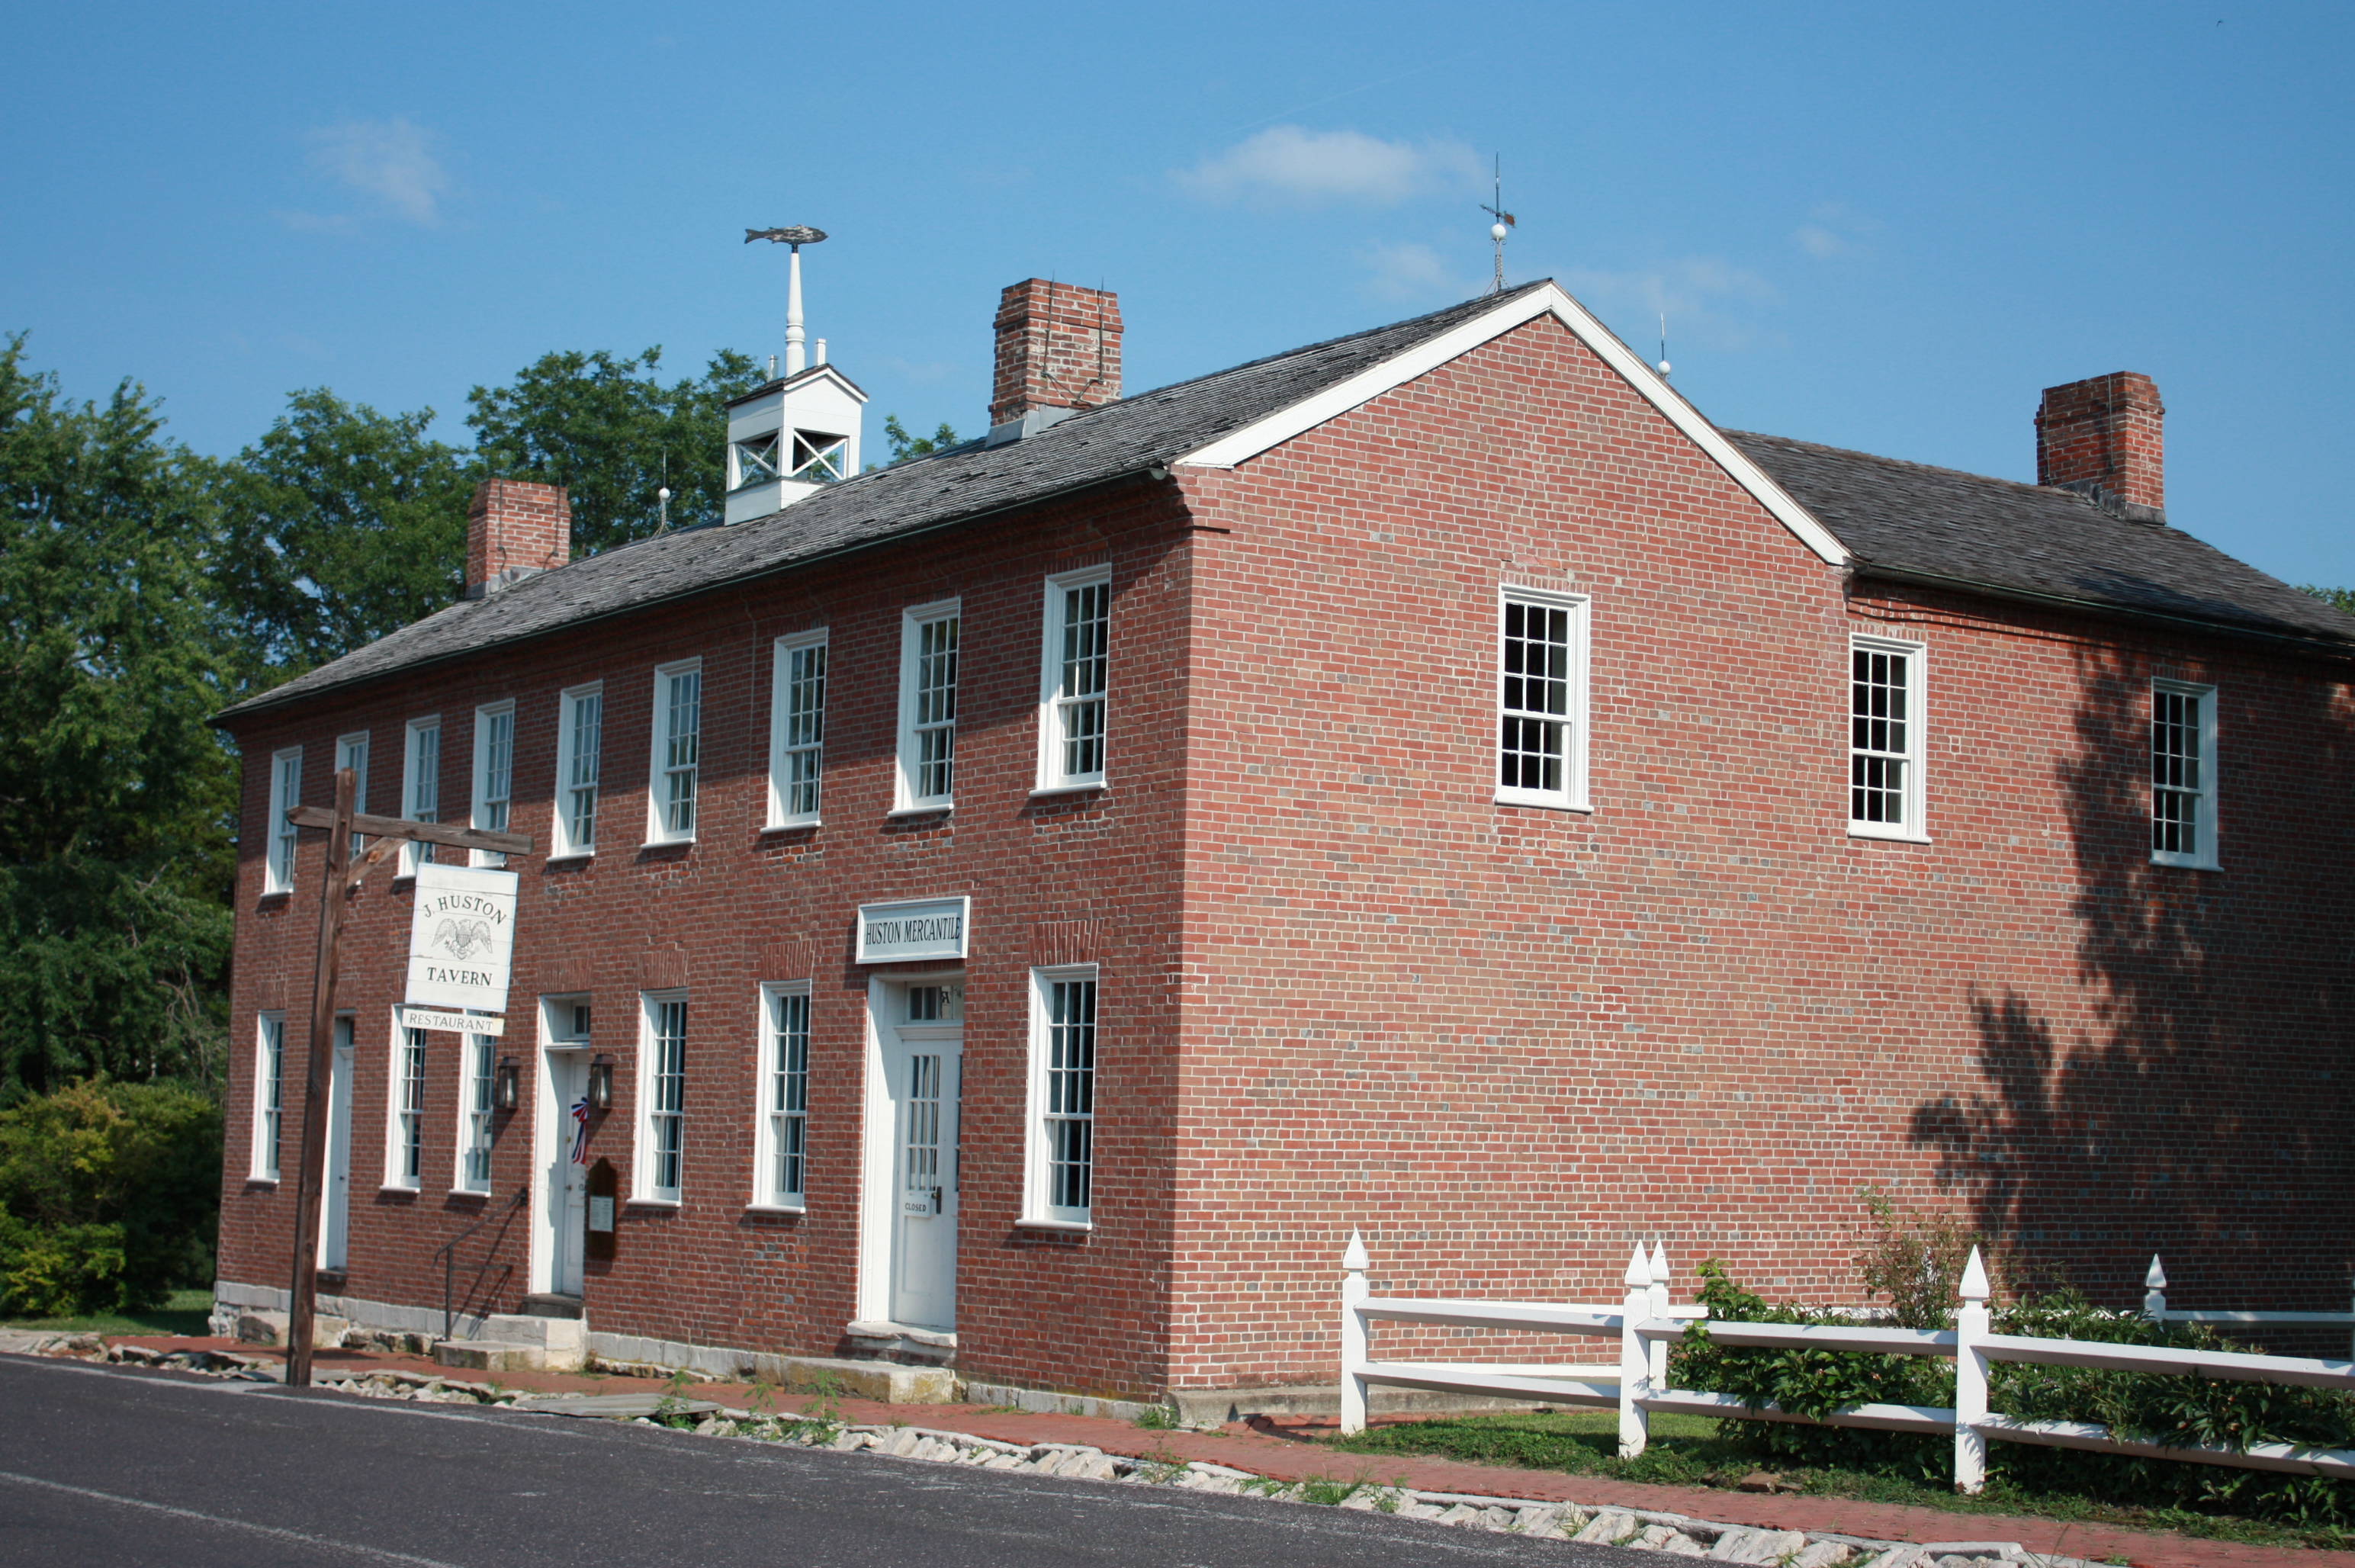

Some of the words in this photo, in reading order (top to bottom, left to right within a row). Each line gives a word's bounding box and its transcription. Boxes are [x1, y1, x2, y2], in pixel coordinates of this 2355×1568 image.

[423, 904, 435, 918] J.
[437, 895, 507, 925] HUSTON
[866, 921, 901, 945] HUSTON
[904, 917, 961, 943] MERCANTILE
[427, 966, 493, 987] TAVERN
[409, 1013, 494, 1032] RESTAURANT
[904, 1202, 927, 1212] CLOSED
